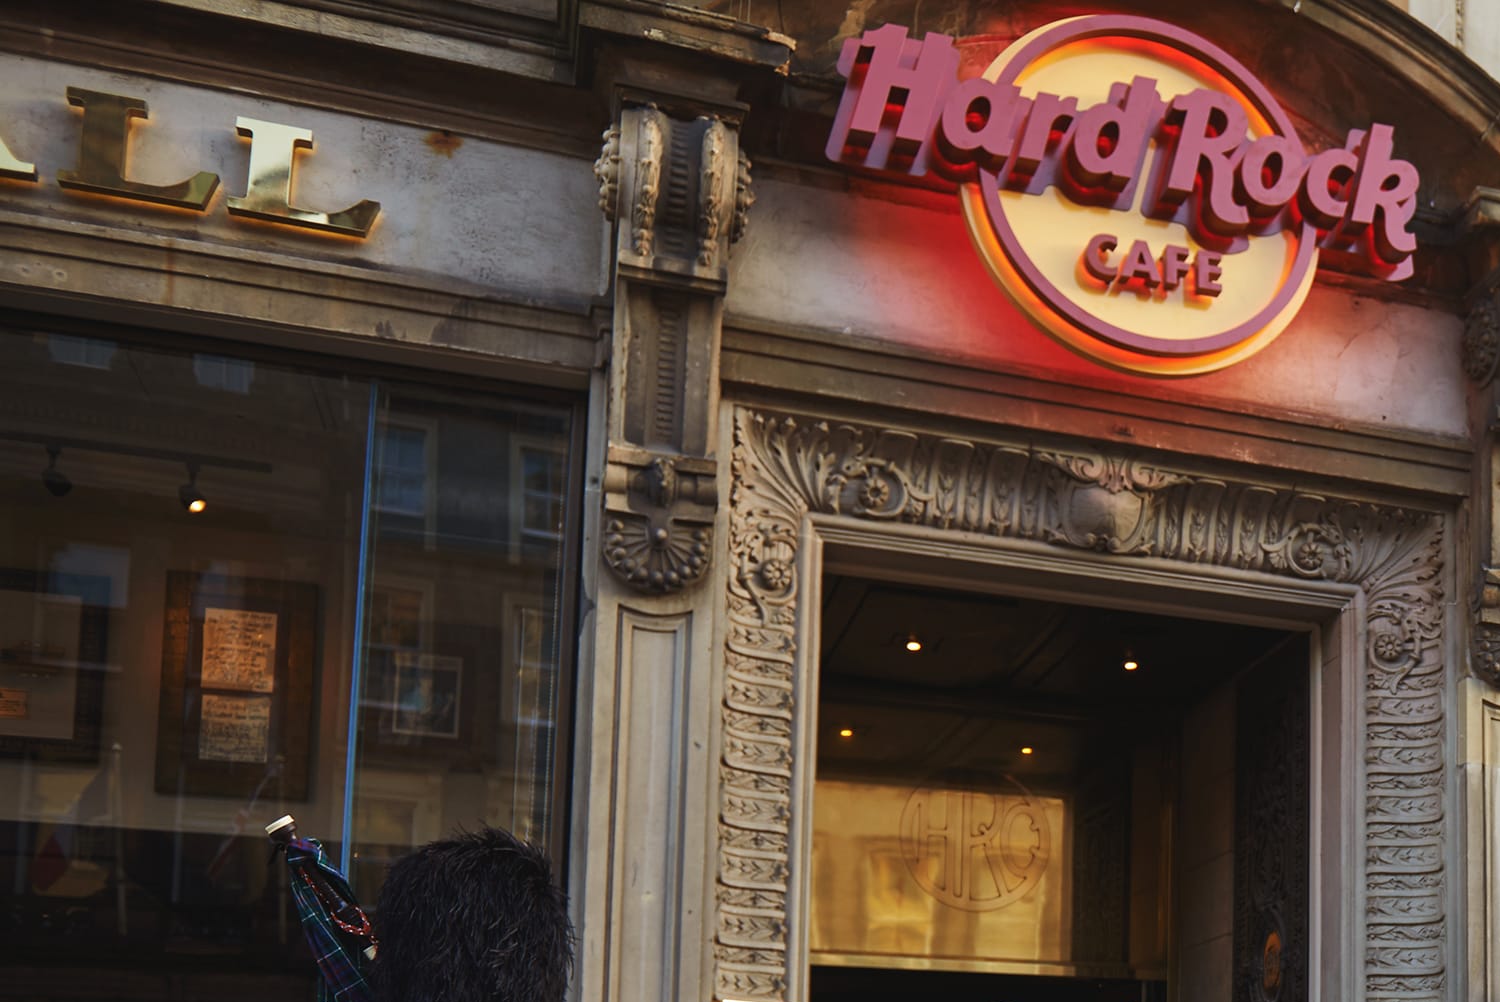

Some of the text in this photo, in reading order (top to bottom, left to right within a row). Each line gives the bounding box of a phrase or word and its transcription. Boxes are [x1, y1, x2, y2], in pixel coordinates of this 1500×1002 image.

[0, 86, 381, 239] LL
[826, 23, 1421, 262] Hard Rock
[1080, 233, 1223, 297] CAFE
